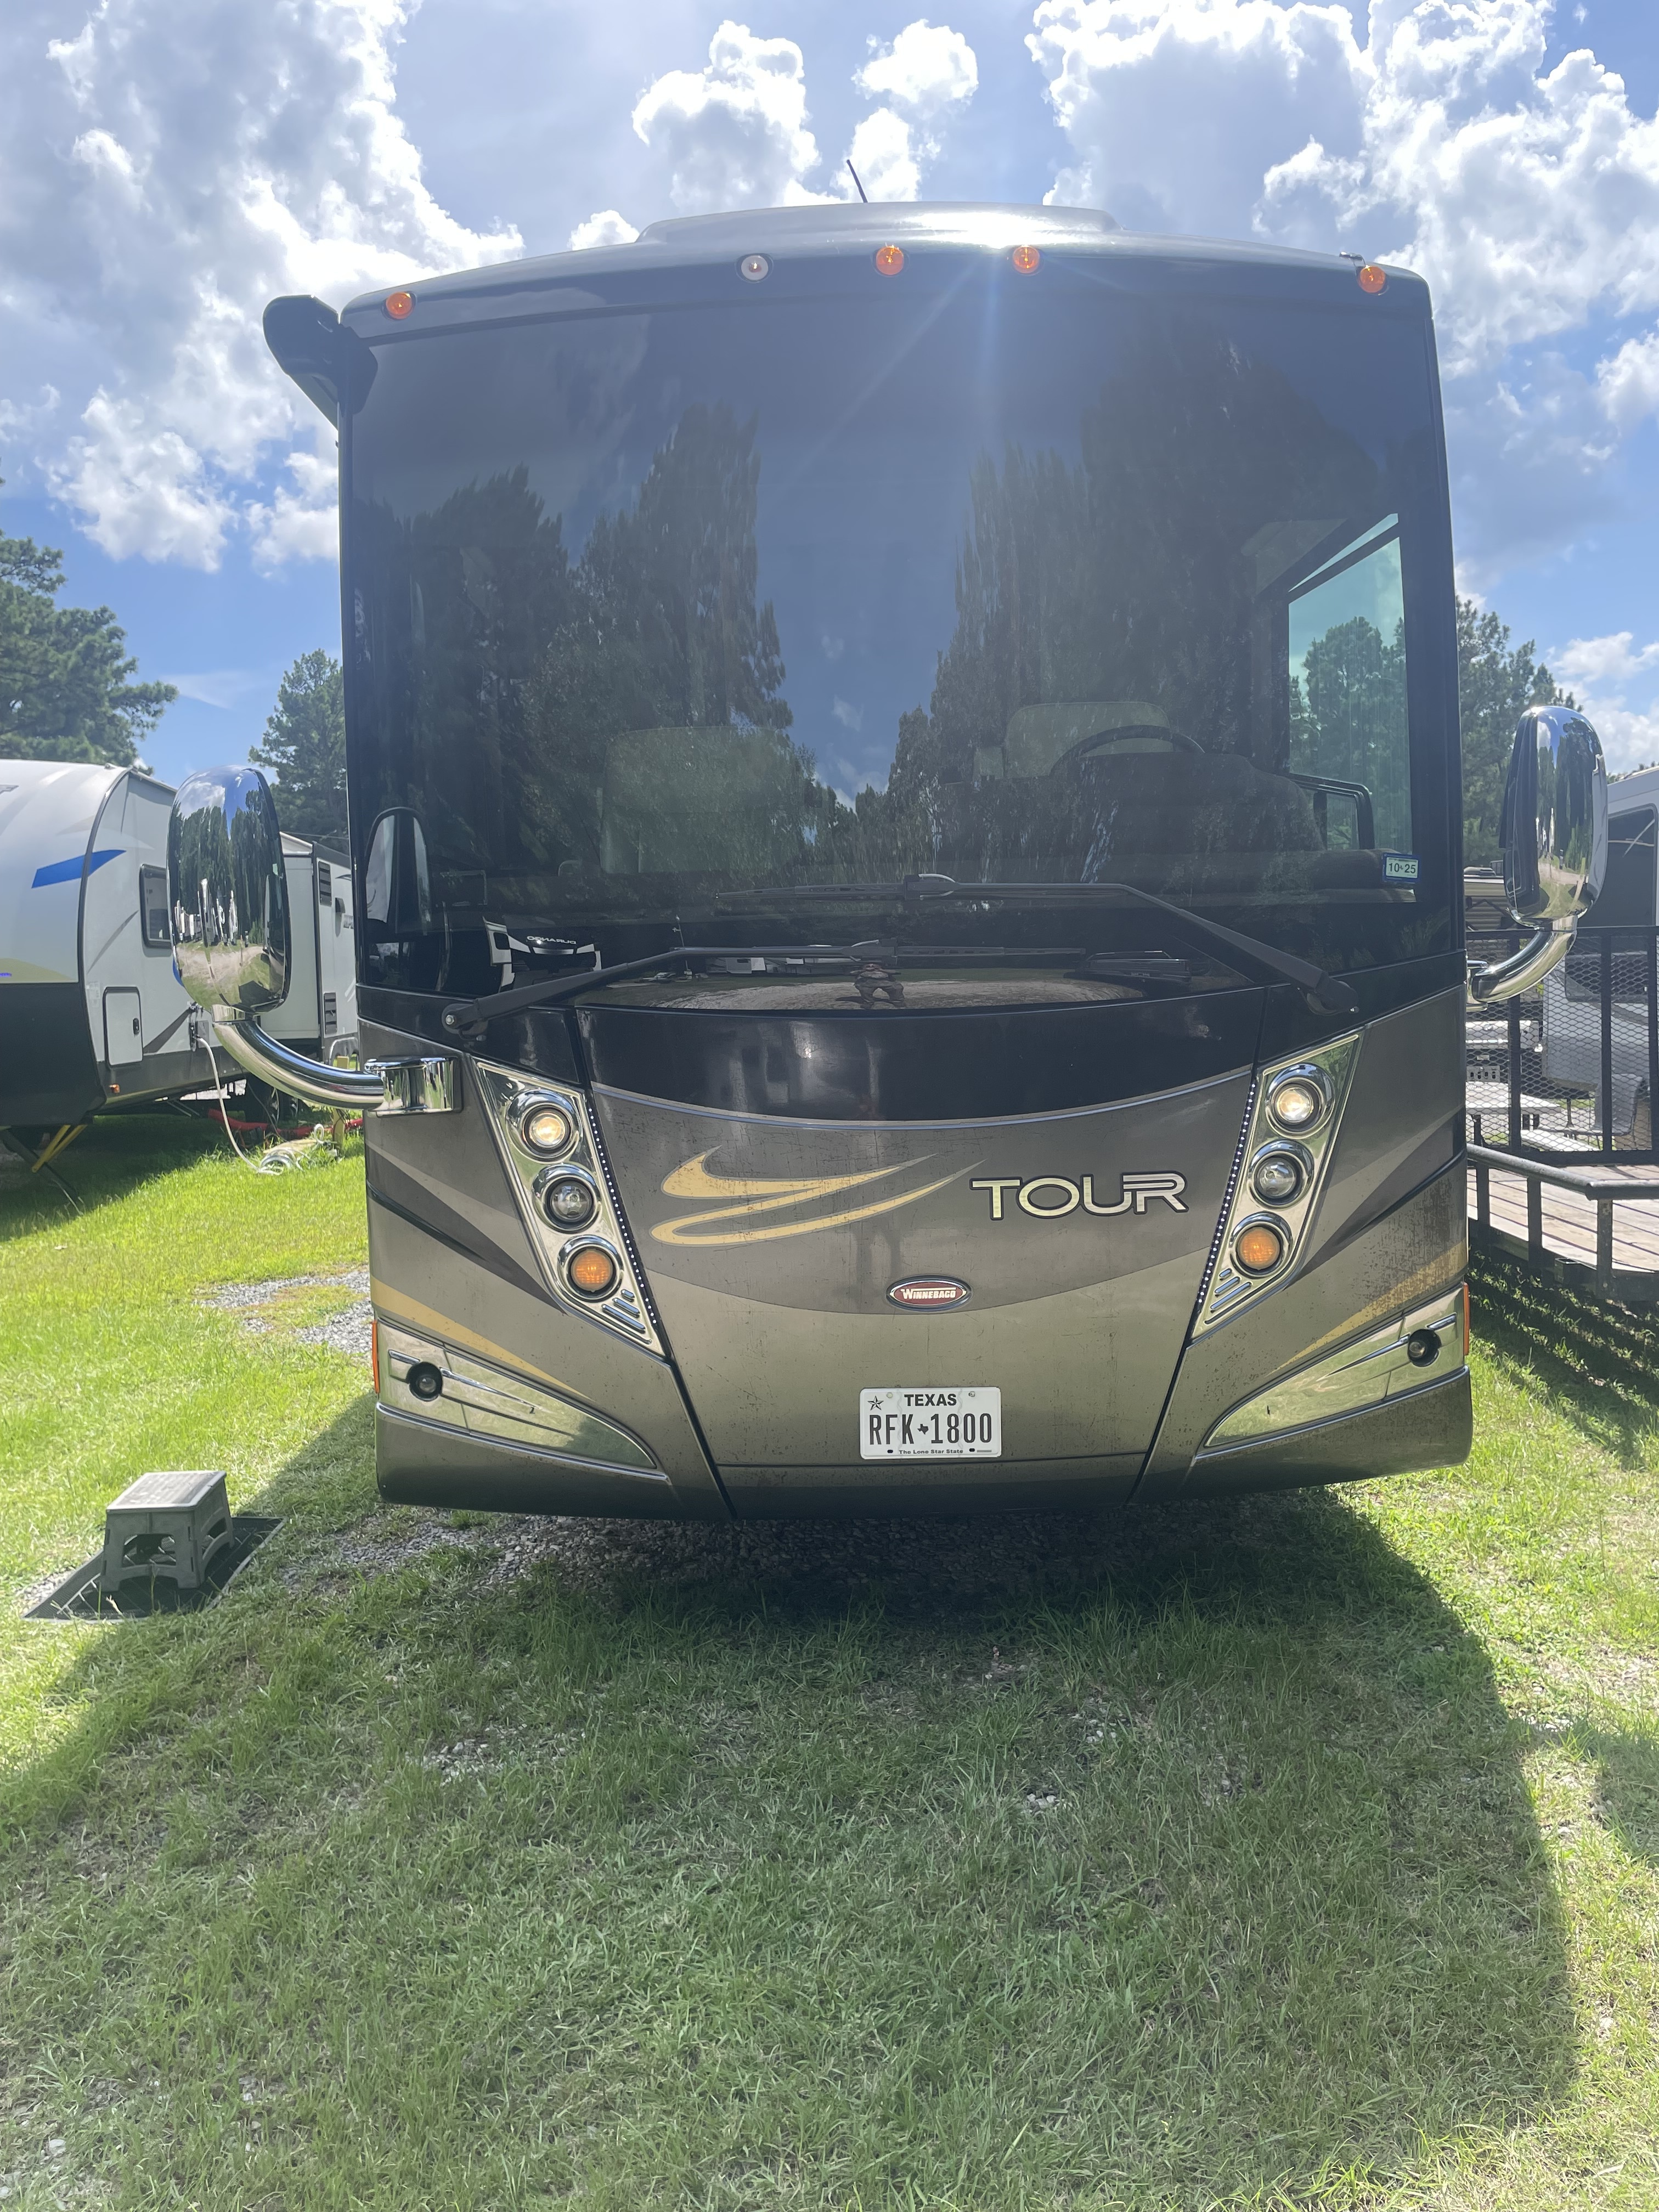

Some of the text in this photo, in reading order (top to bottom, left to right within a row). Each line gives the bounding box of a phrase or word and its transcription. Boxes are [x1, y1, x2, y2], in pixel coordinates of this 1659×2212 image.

[970, 1171, 1189, 1220] TOUR
[900, 1287, 956, 1299] WINNEBAGO
[904, 1393, 957, 1406] TEXAS
